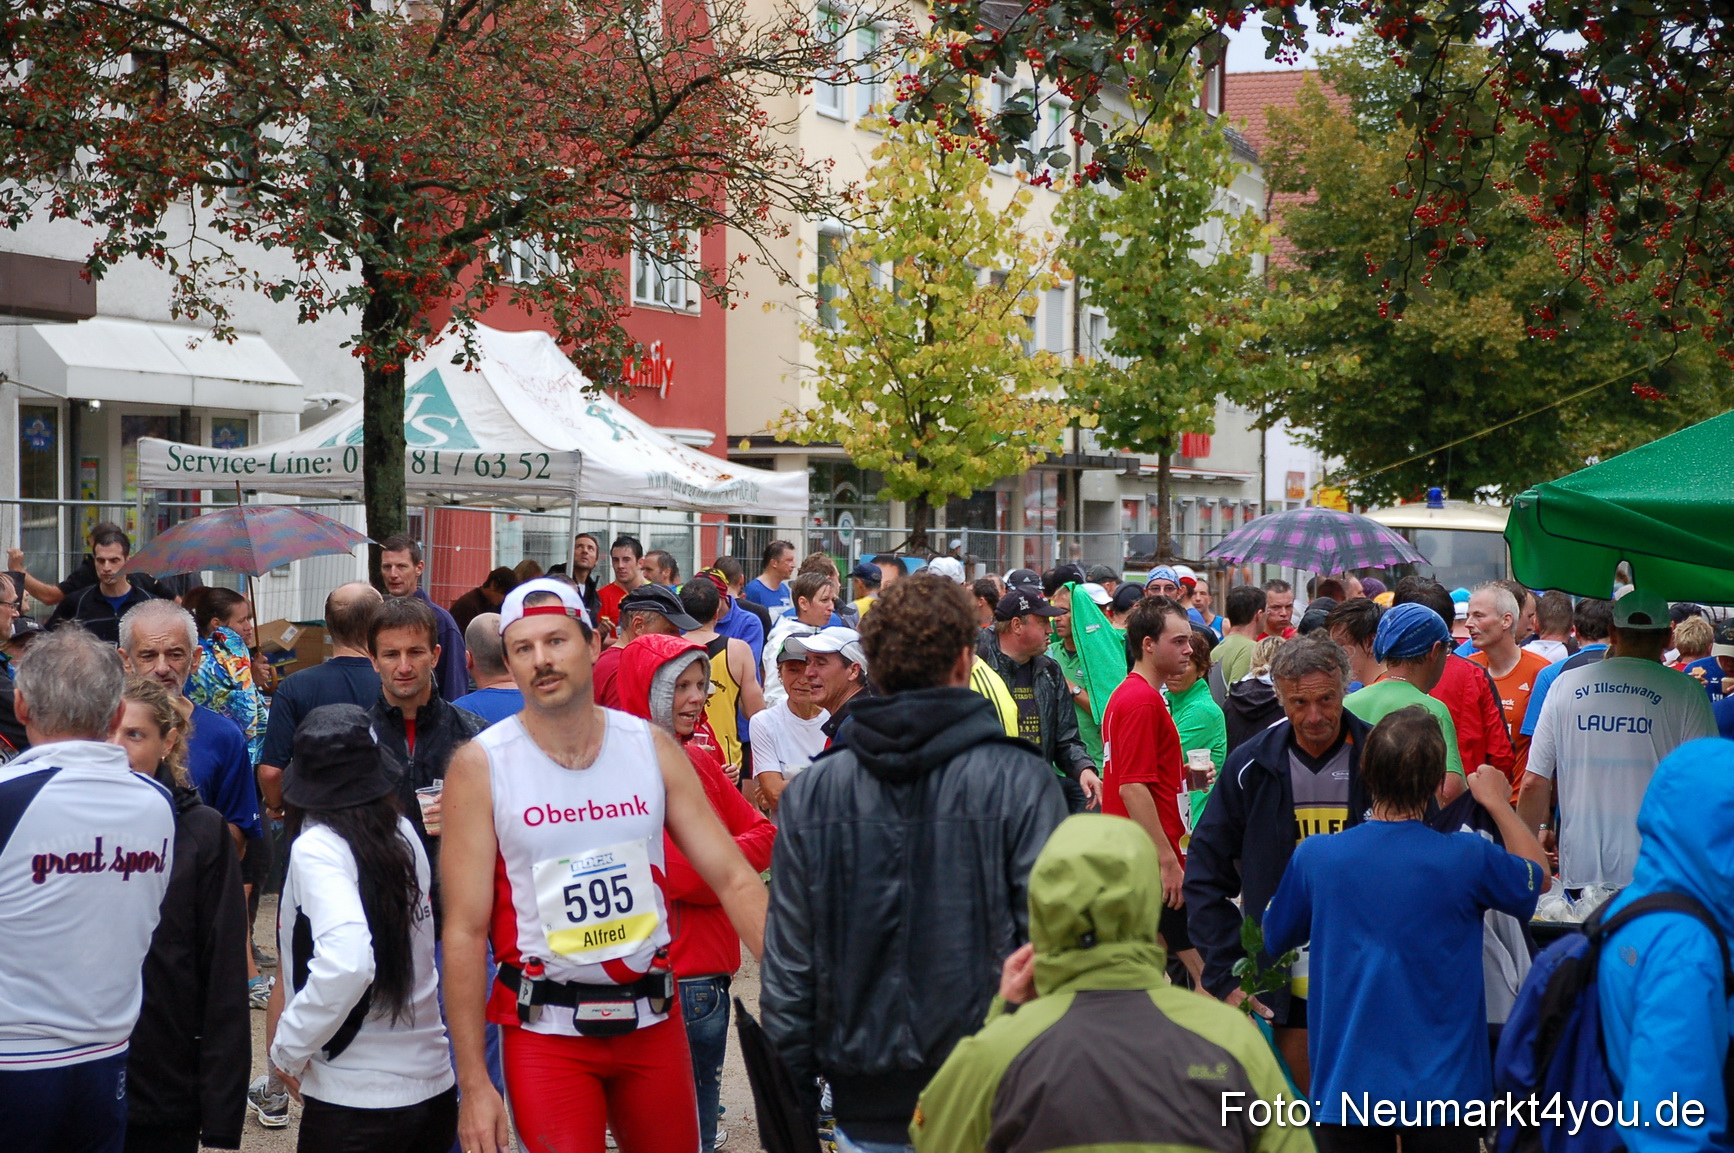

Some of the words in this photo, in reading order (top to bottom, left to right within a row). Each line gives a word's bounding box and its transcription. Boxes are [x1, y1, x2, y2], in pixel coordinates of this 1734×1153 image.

[167, 445, 332, 474] Service-Line:
[453, 452, 464, 476] /
[474, 453, 507, 479] 63
[518, 453, 551, 480] 52
[1575, 685, 1590, 699] SV
[1594, 682, 1662, 705] Illschwang
[1577, 714, 1652, 734] LAUF10!
[523, 795, 649, 826] Oberbank
[32, 836, 107, 885] great
[108, 838, 168, 881] sport
[563, 873, 634, 924] 595
[583, 924, 626, 948] Alfred
